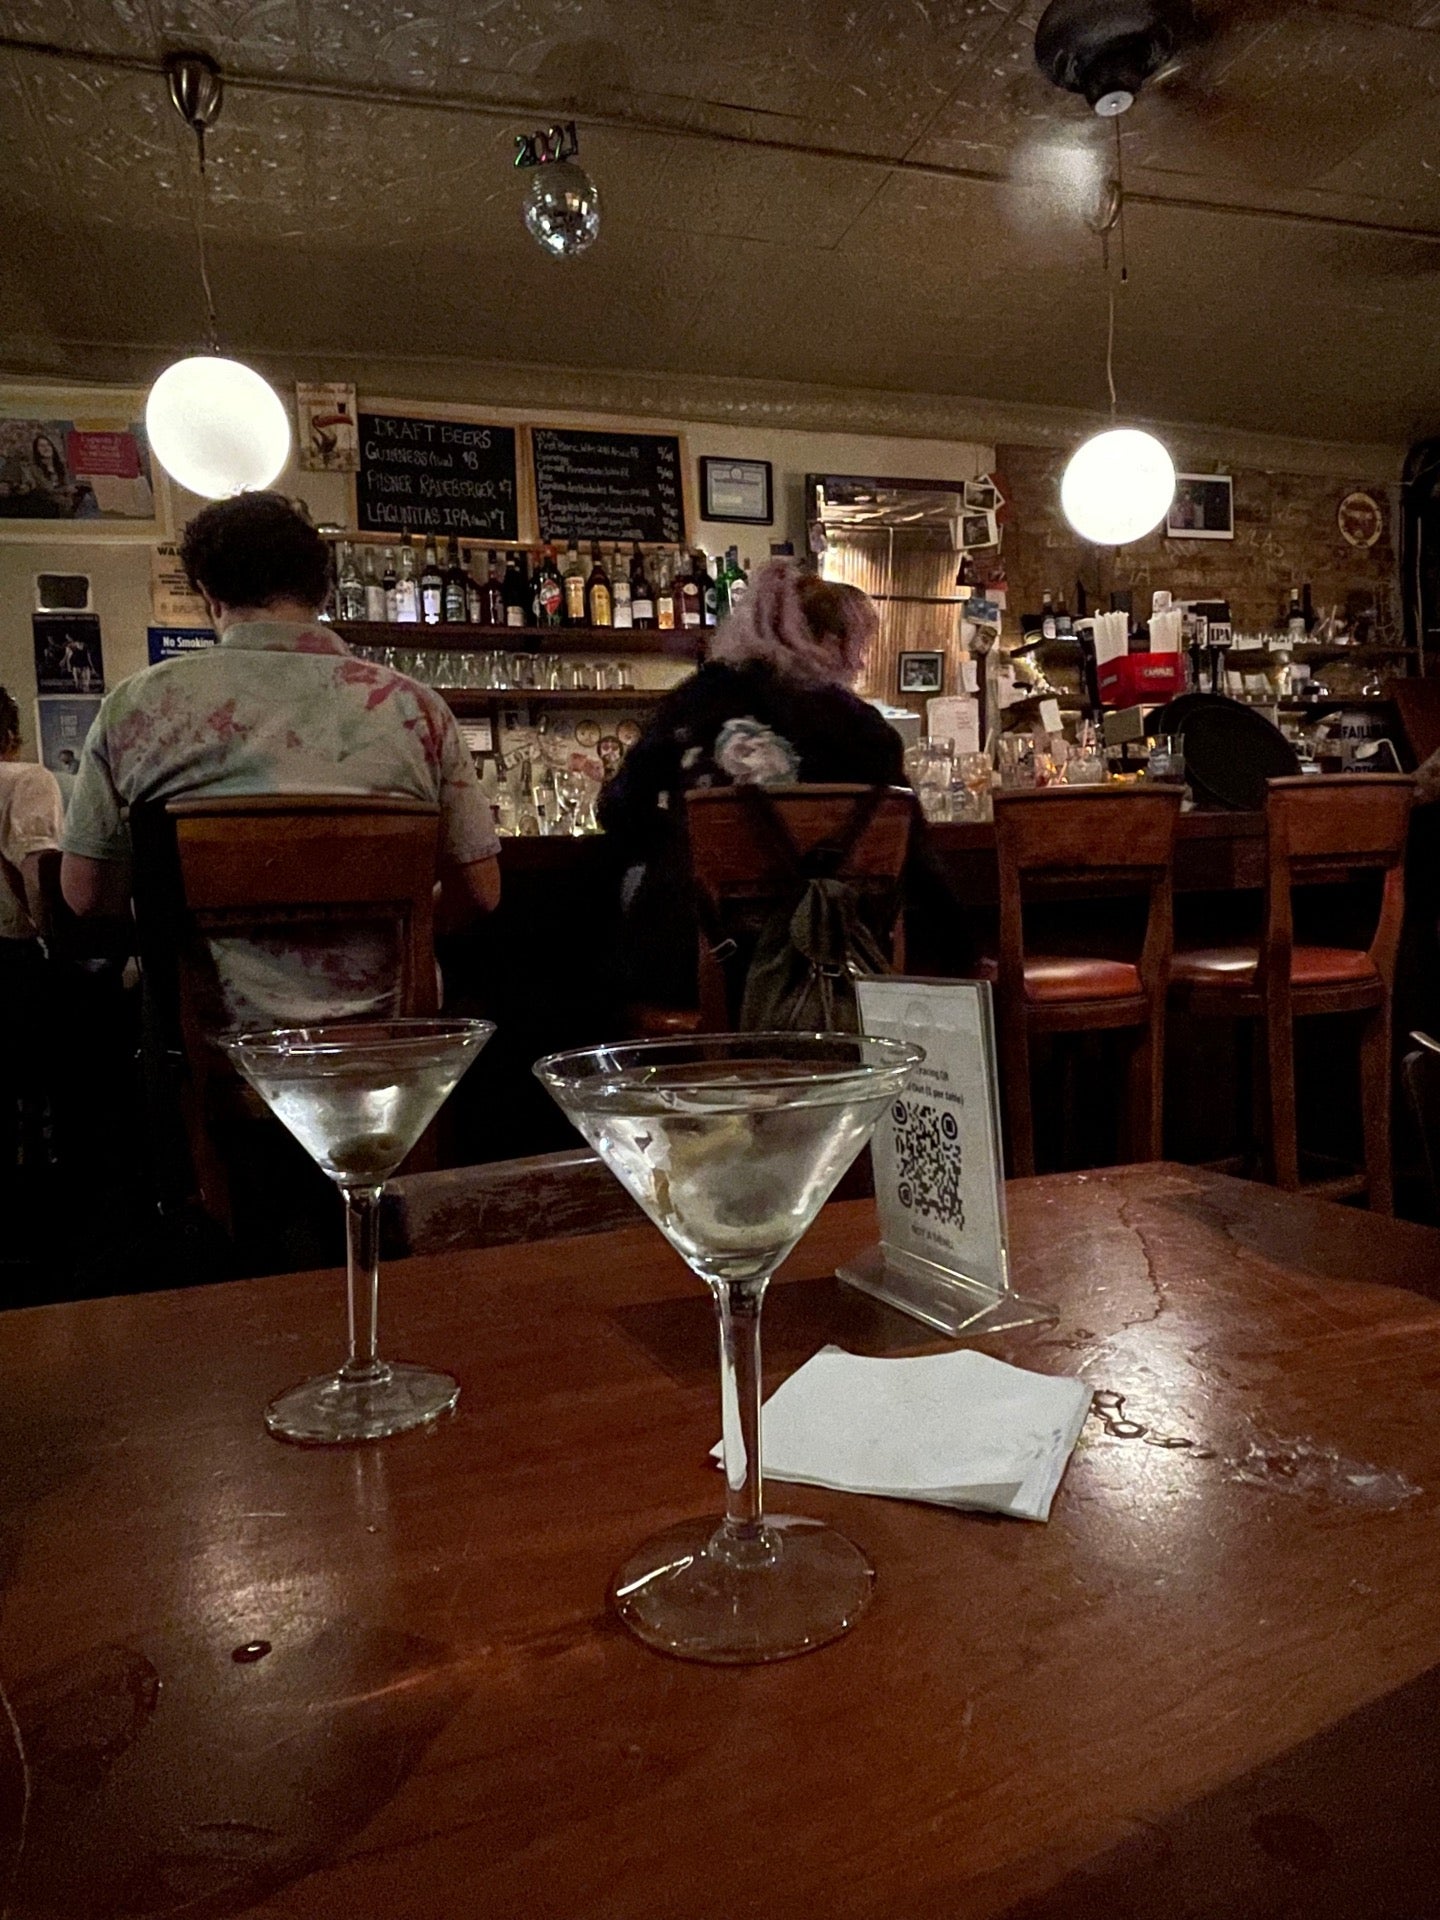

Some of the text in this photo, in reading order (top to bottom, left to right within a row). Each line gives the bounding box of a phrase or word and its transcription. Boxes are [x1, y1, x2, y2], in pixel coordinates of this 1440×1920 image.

[374, 418, 491, 448] DRAFT BEERS
[367, 469, 412, 494] PILSNER
[366, 502, 440, 526] LAGUNITAS
[444, 508, 471, 527] IPA
[163, 636, 215, 648] No Smoking
